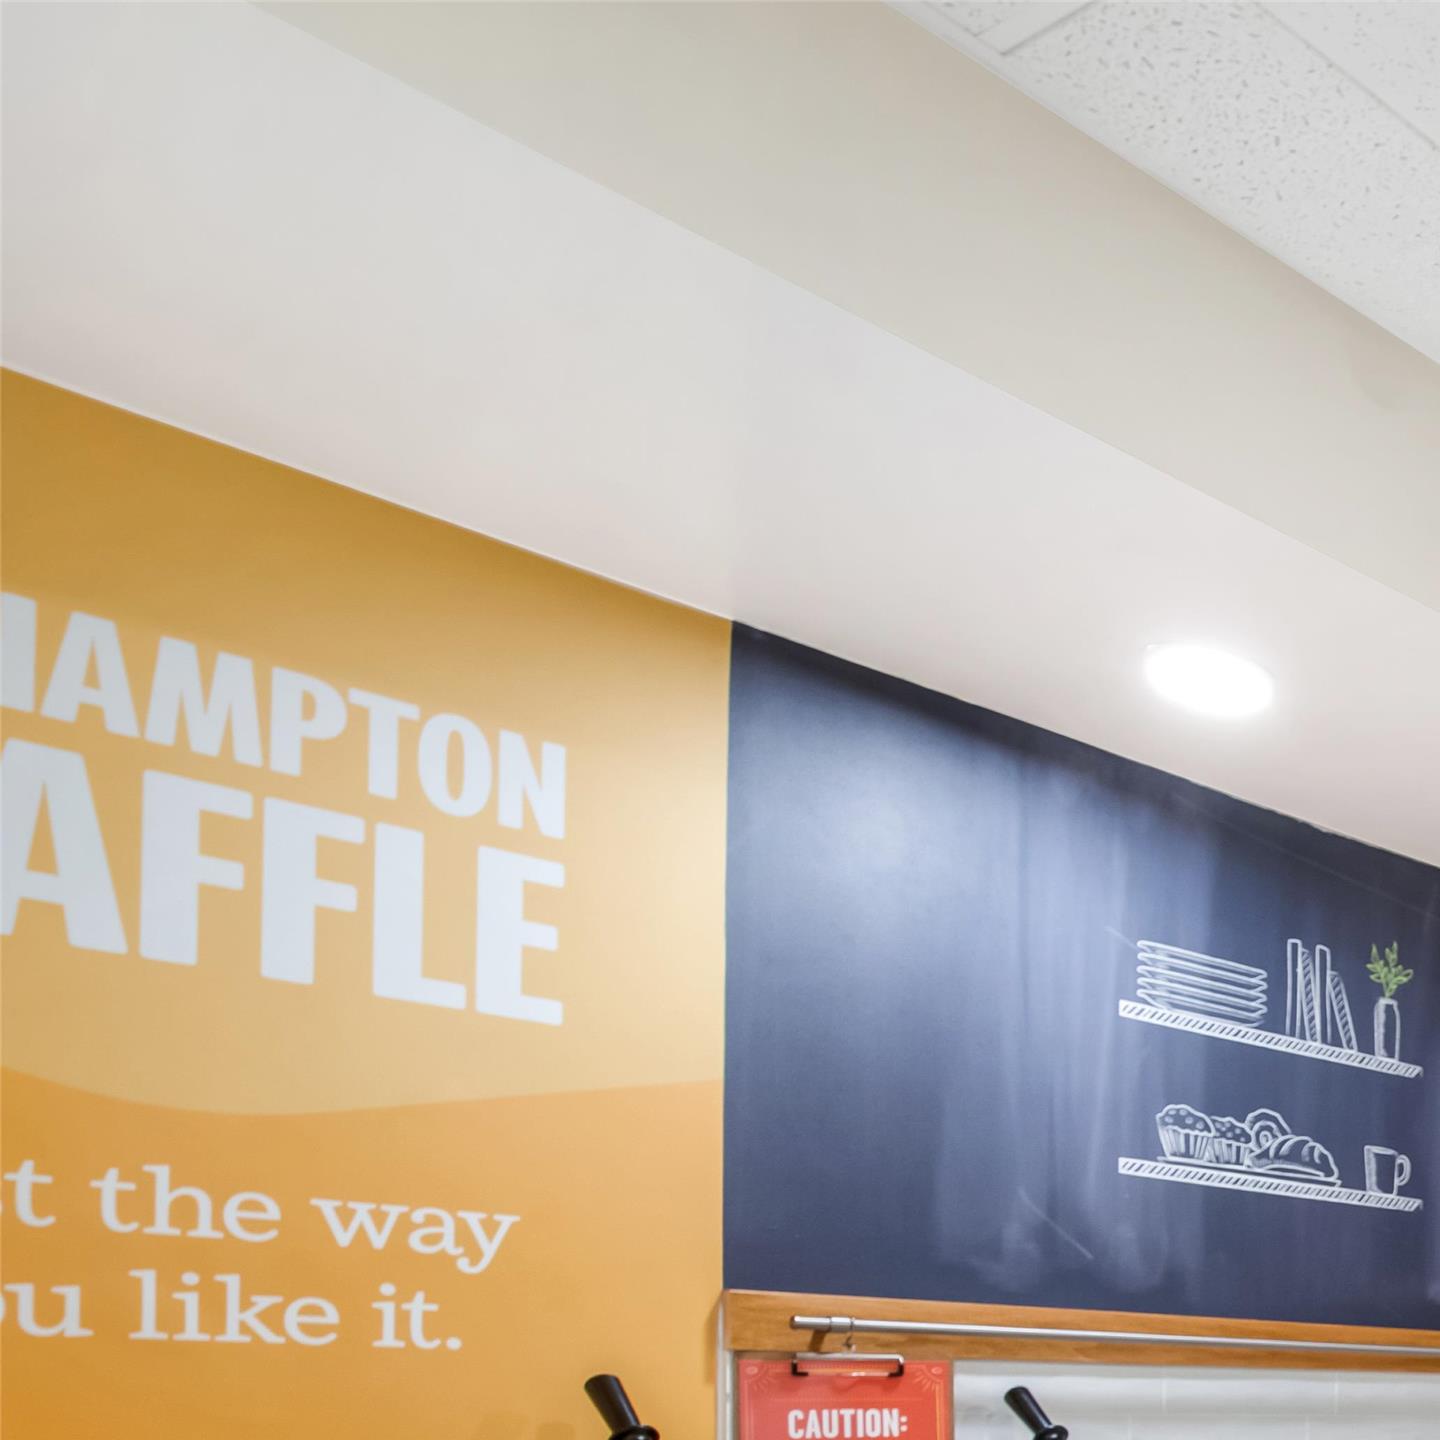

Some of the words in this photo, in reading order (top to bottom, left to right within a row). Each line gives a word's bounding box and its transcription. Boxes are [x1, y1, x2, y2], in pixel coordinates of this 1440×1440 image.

[89, 1164, 282, 1243] the
[309, 1197, 521, 1274] way
[0, 1282, 96, 1338] u
[128, 1268, 341, 1347] like
[371, 1282, 463, 1352] it.
[787, 1408, 908, 1440] CAUTION:
